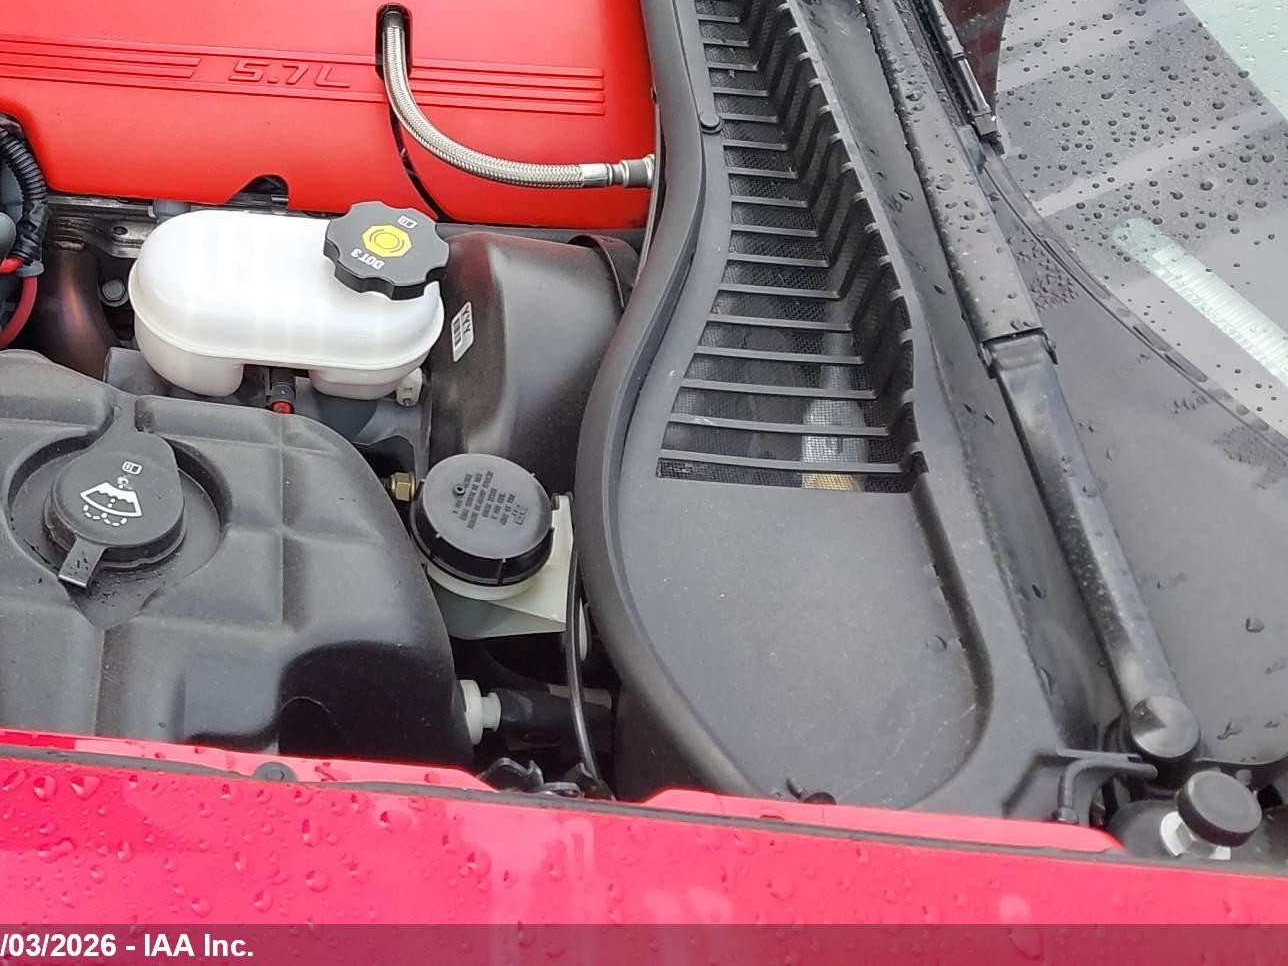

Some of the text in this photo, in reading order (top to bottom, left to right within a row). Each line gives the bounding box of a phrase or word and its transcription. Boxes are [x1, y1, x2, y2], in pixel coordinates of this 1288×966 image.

[227, 56, 354, 89] 5.7L
[350, 248, 385, 270] DOT 3
